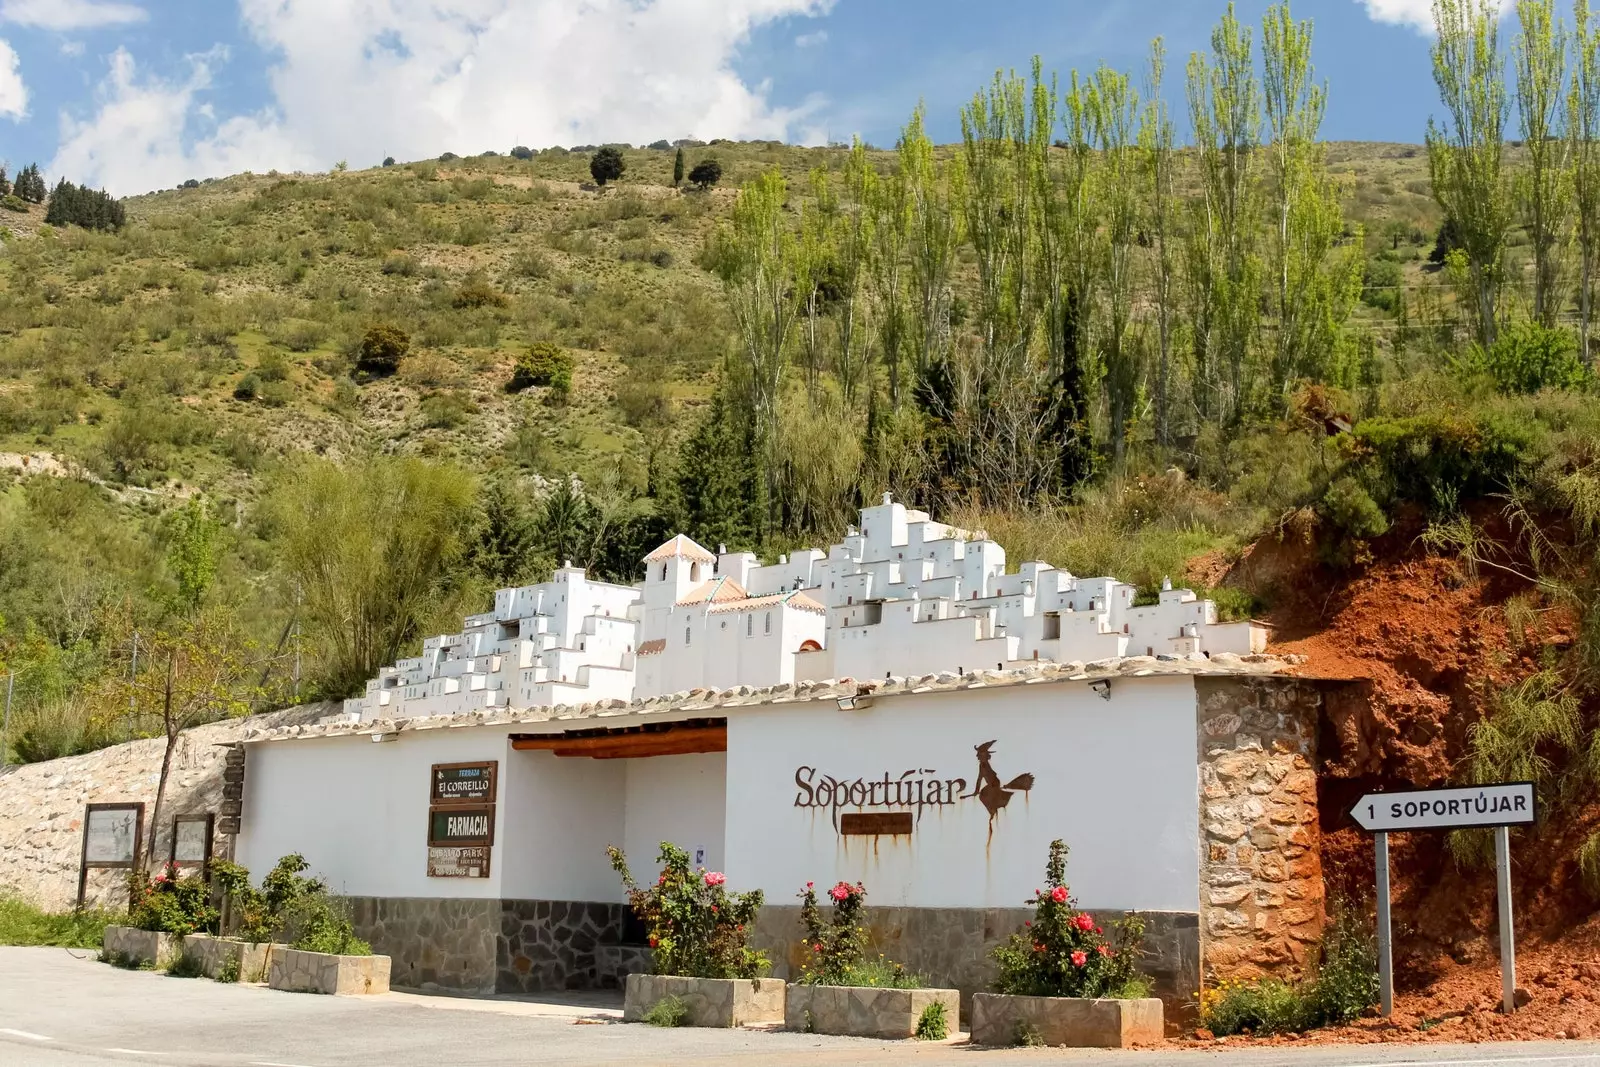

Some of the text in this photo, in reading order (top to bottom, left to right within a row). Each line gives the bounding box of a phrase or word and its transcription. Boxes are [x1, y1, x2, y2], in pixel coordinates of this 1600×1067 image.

[459, 769, 480, 777] TERRAZA
[447, 780, 489, 792] CORREILLO
[794, 765, 967, 834] Soportújar
[1367, 791, 1527, 820] 1 SOPORTÚJAR
[447, 816, 488, 836] FARMACIA
[462, 848, 483, 858] PARK
